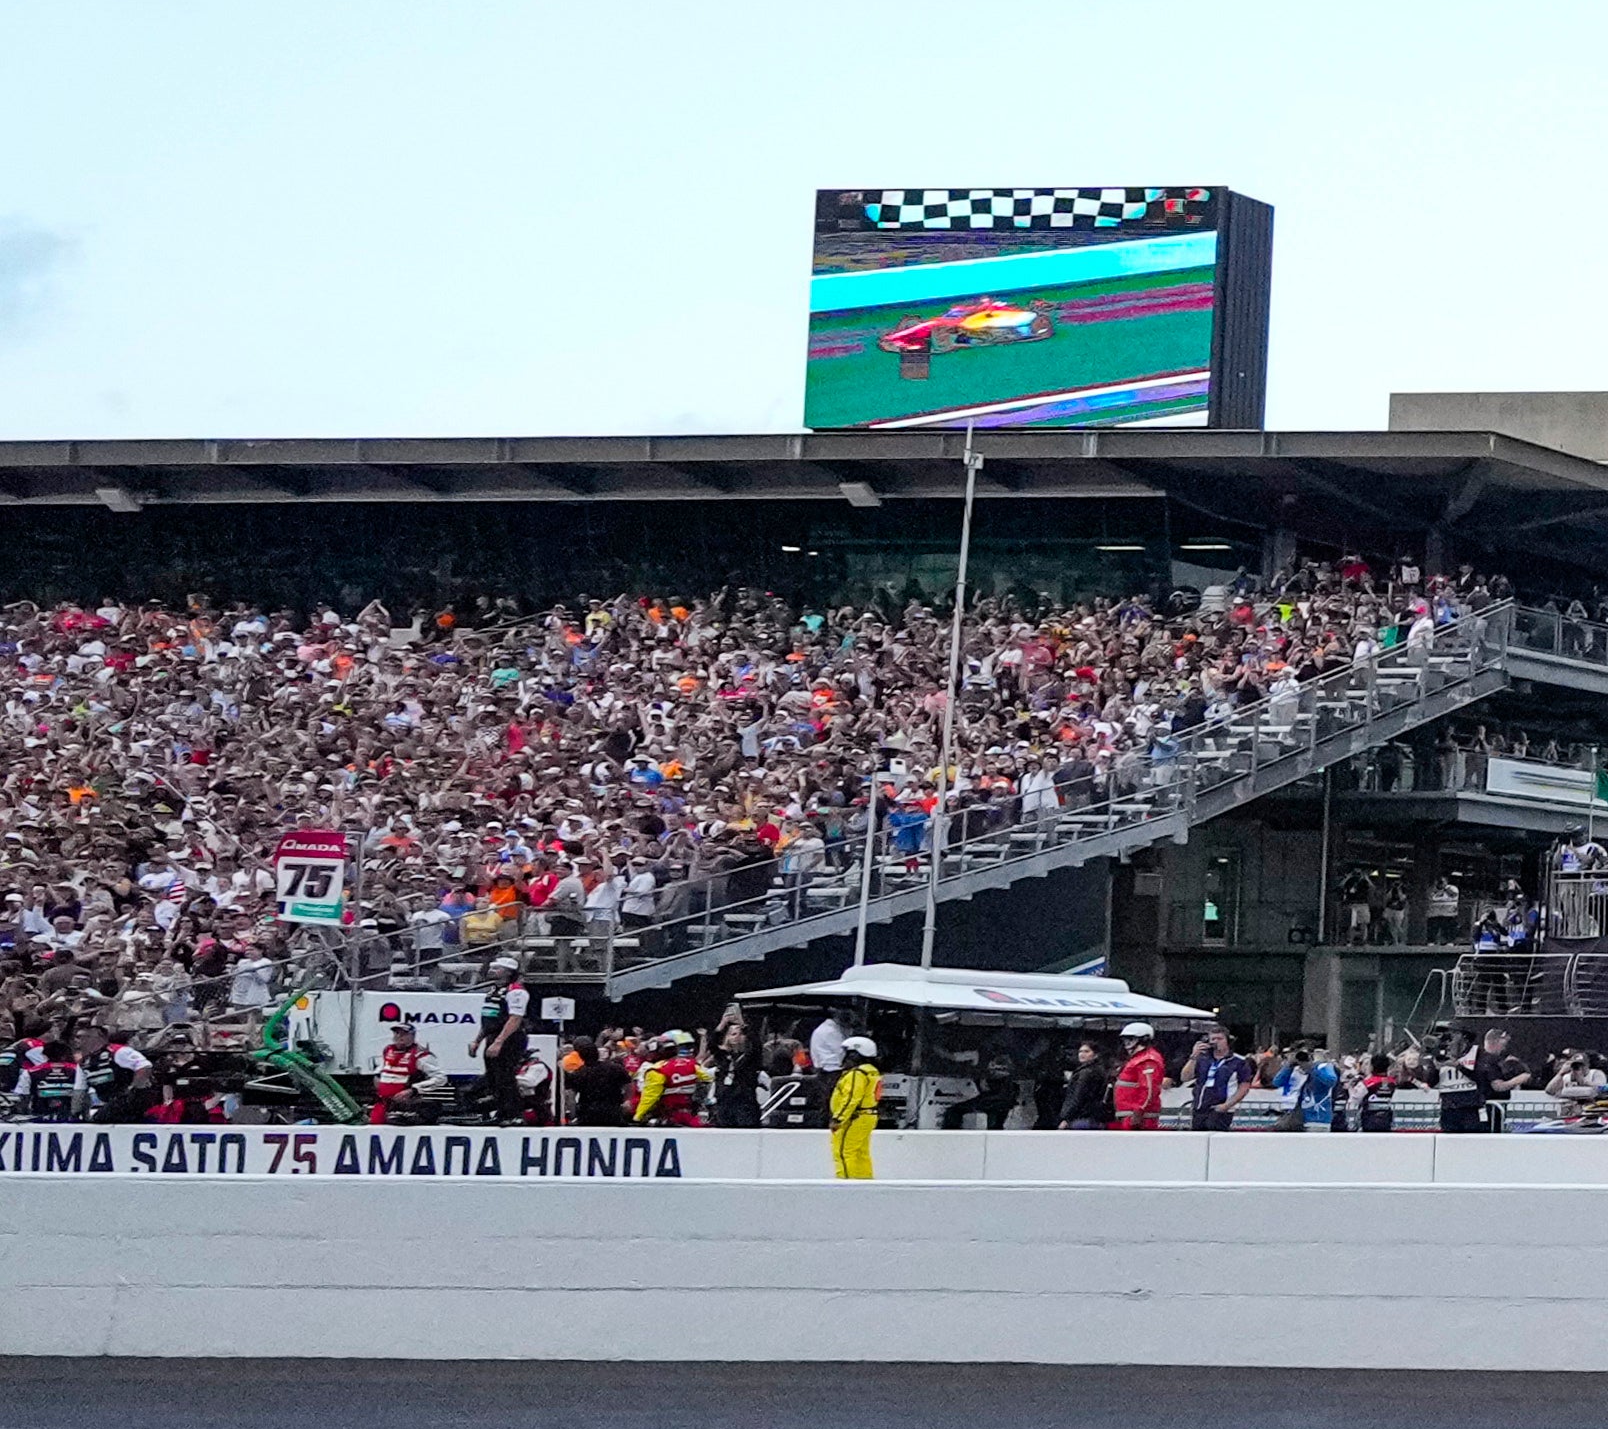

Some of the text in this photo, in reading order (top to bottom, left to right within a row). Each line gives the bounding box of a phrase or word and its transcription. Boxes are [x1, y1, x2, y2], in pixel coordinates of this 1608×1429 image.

[283, 864, 338, 899] 75
[263, 1133, 318, 1174] 75
[332, 1134, 502, 1176] AMADA
[520, 1136, 682, 1178] HONDA
